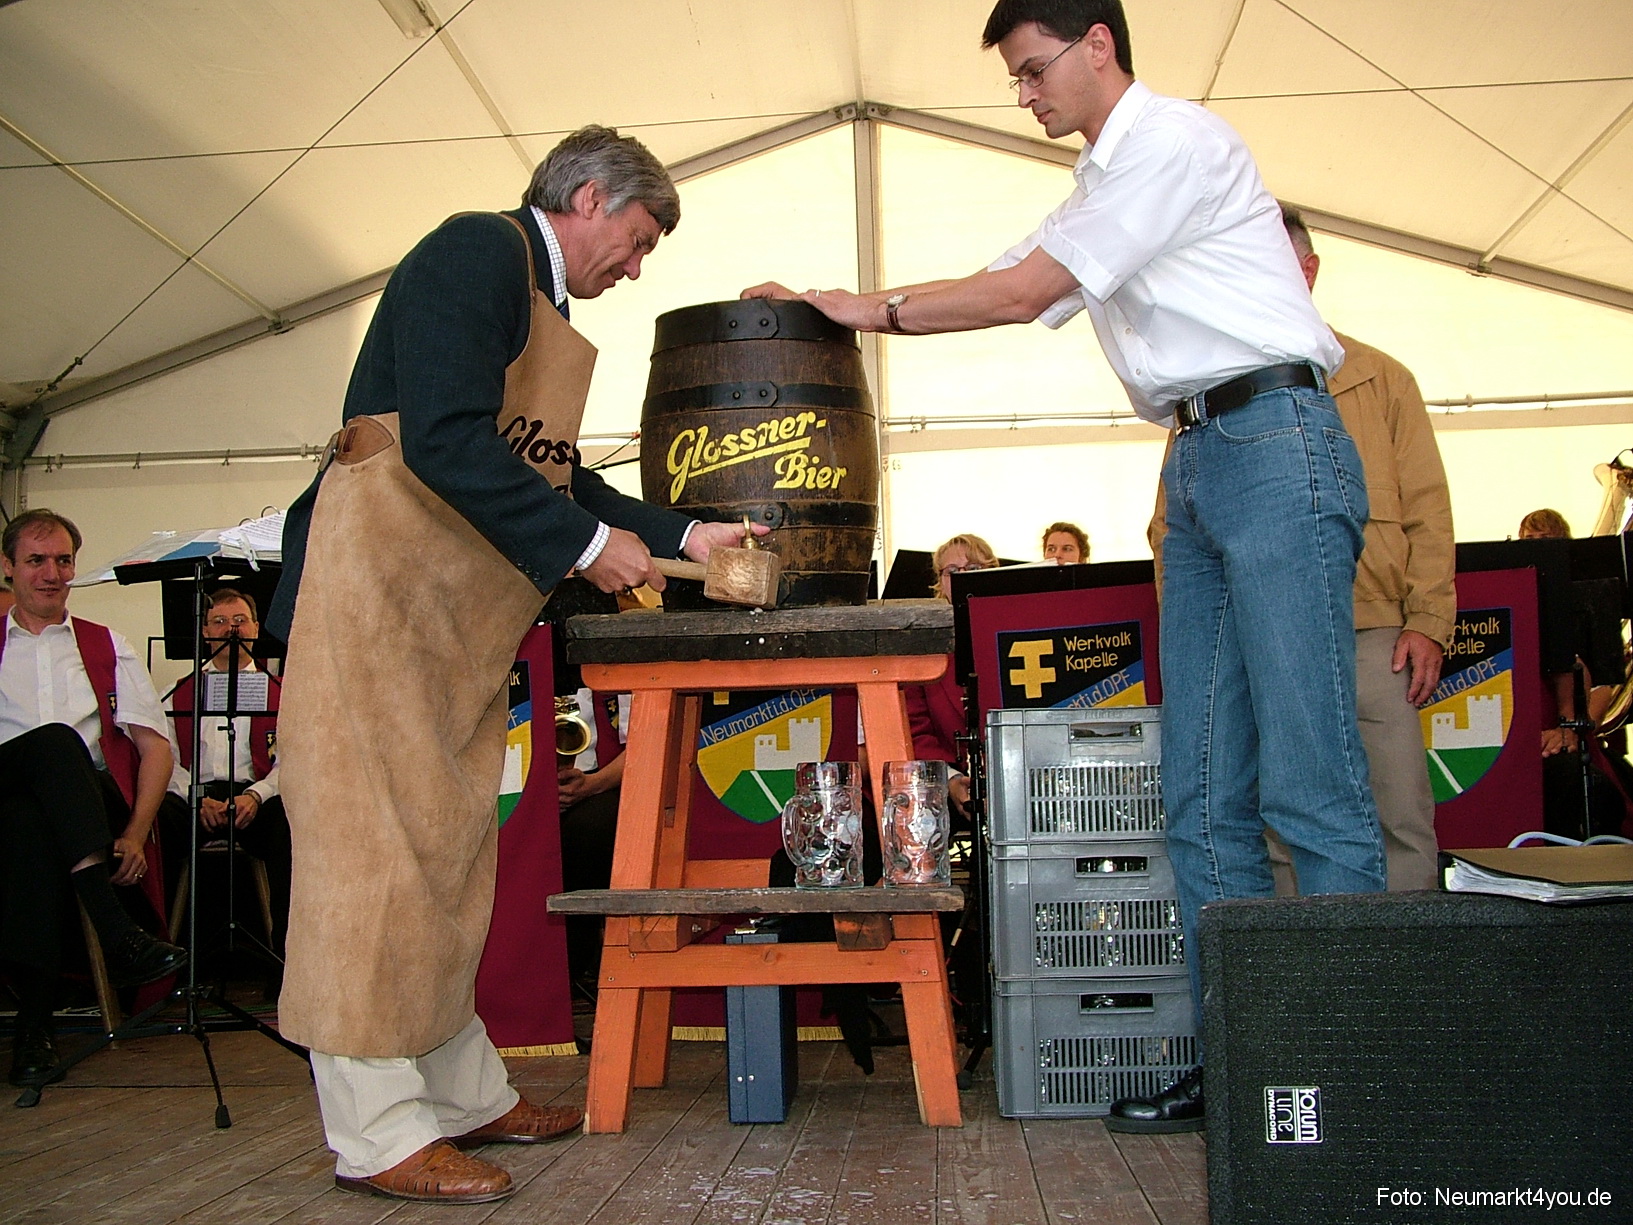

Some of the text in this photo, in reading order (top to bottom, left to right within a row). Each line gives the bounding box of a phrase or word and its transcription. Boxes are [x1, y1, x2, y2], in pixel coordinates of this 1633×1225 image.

[667, 411, 827, 504] Glossner-
[773, 450, 847, 489] Bier
[1453, 616, 1500, 636] rkvolk
[1063, 631, 1132, 652] Werkvolk
[1443, 638, 1486, 660] pelle
[1065, 652, 1119, 673] Kapelle
[1268, 1089, 1278, 1141] DYNACORD
